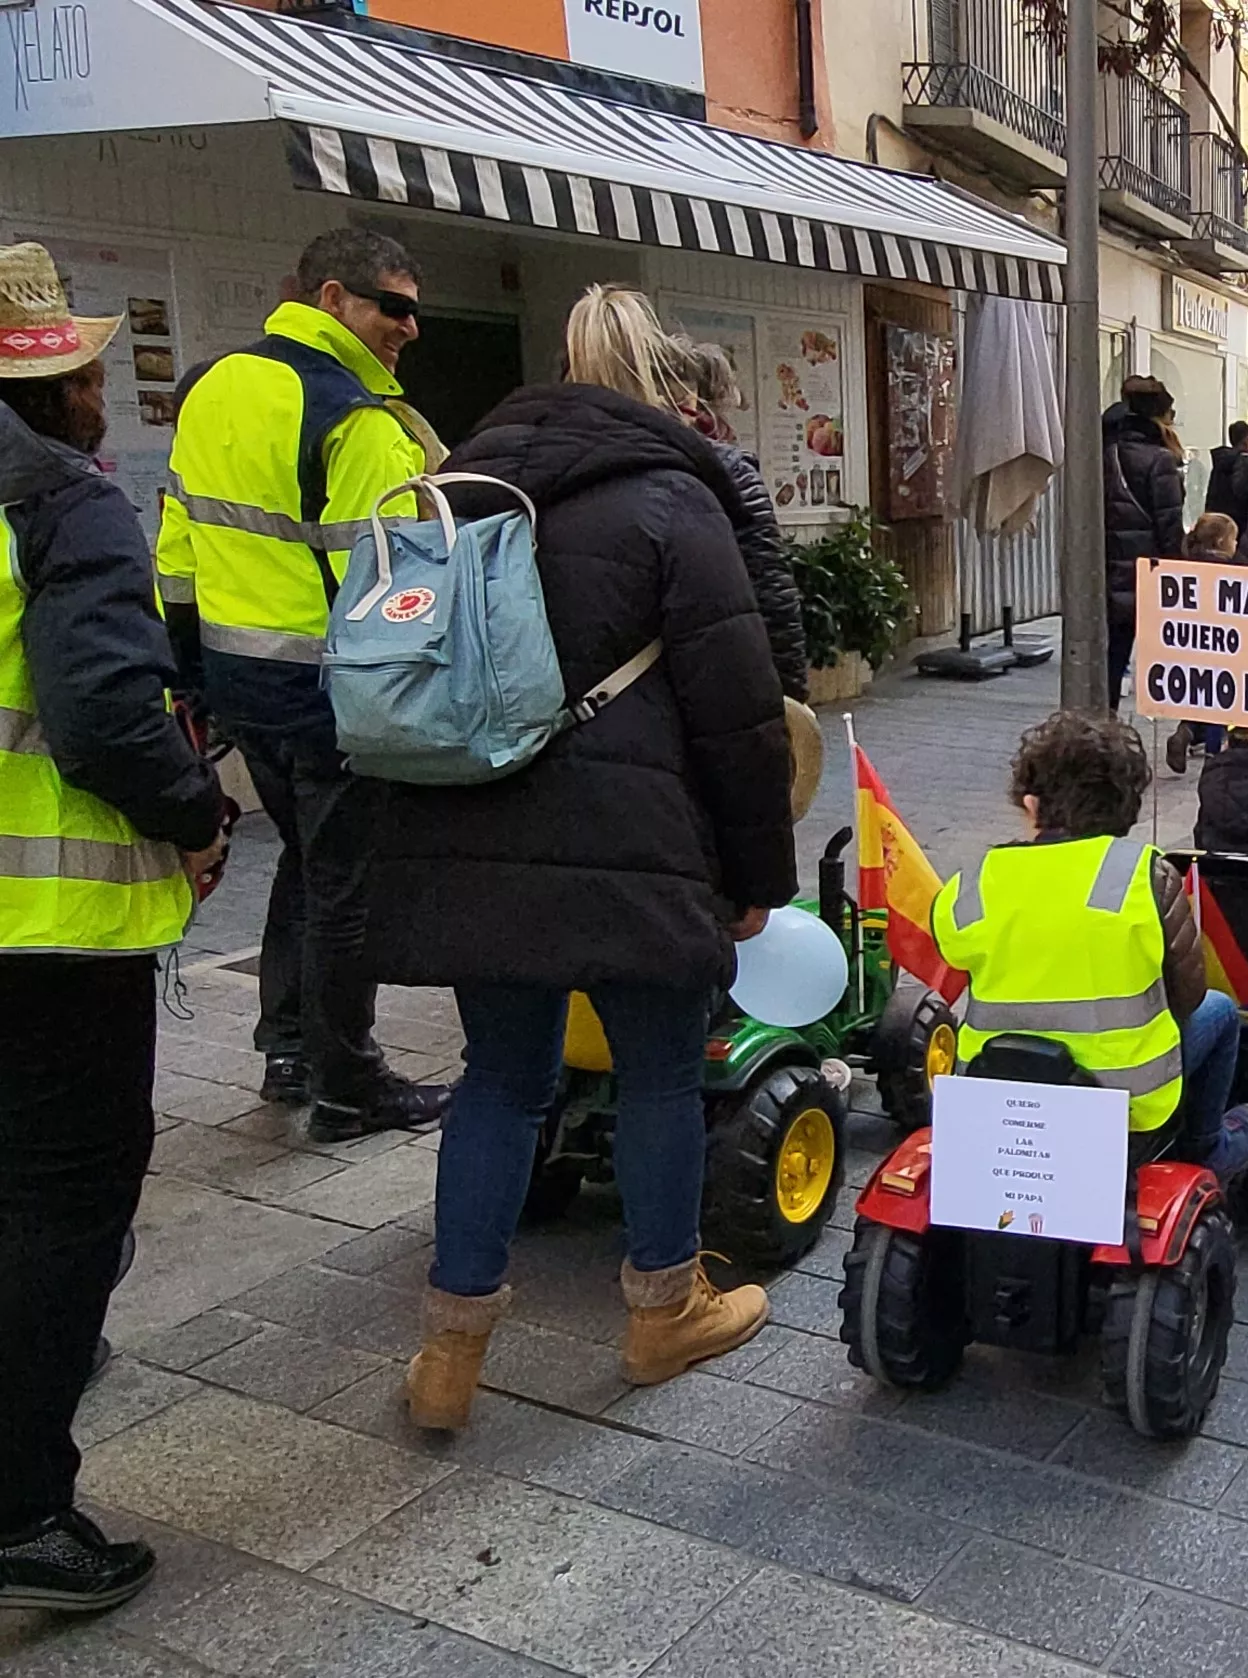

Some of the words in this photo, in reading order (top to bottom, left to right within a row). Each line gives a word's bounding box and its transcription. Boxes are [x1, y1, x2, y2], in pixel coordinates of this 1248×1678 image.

[584, 0, 685, 37] REPSOL
[6, 5, 90, 111] XELATO
[1160, 575, 1198, 609] DE
[1162, 620, 1240, 654] QUIERO
[1148, 663, 1236, 710] COMO
[1006, 1099, 1041, 1109] QUIERO
[1002, 1118, 1046, 1130] COMERME
[1015, 1138, 1033, 1146] LAS
[997, 1147, 1051, 1159] PALOMITAS
[992, 1167, 1010, 1177] QUE
[1012, 1169, 1055, 1181] PRODUCE
[1004, 1191, 1015, 1200] MI
